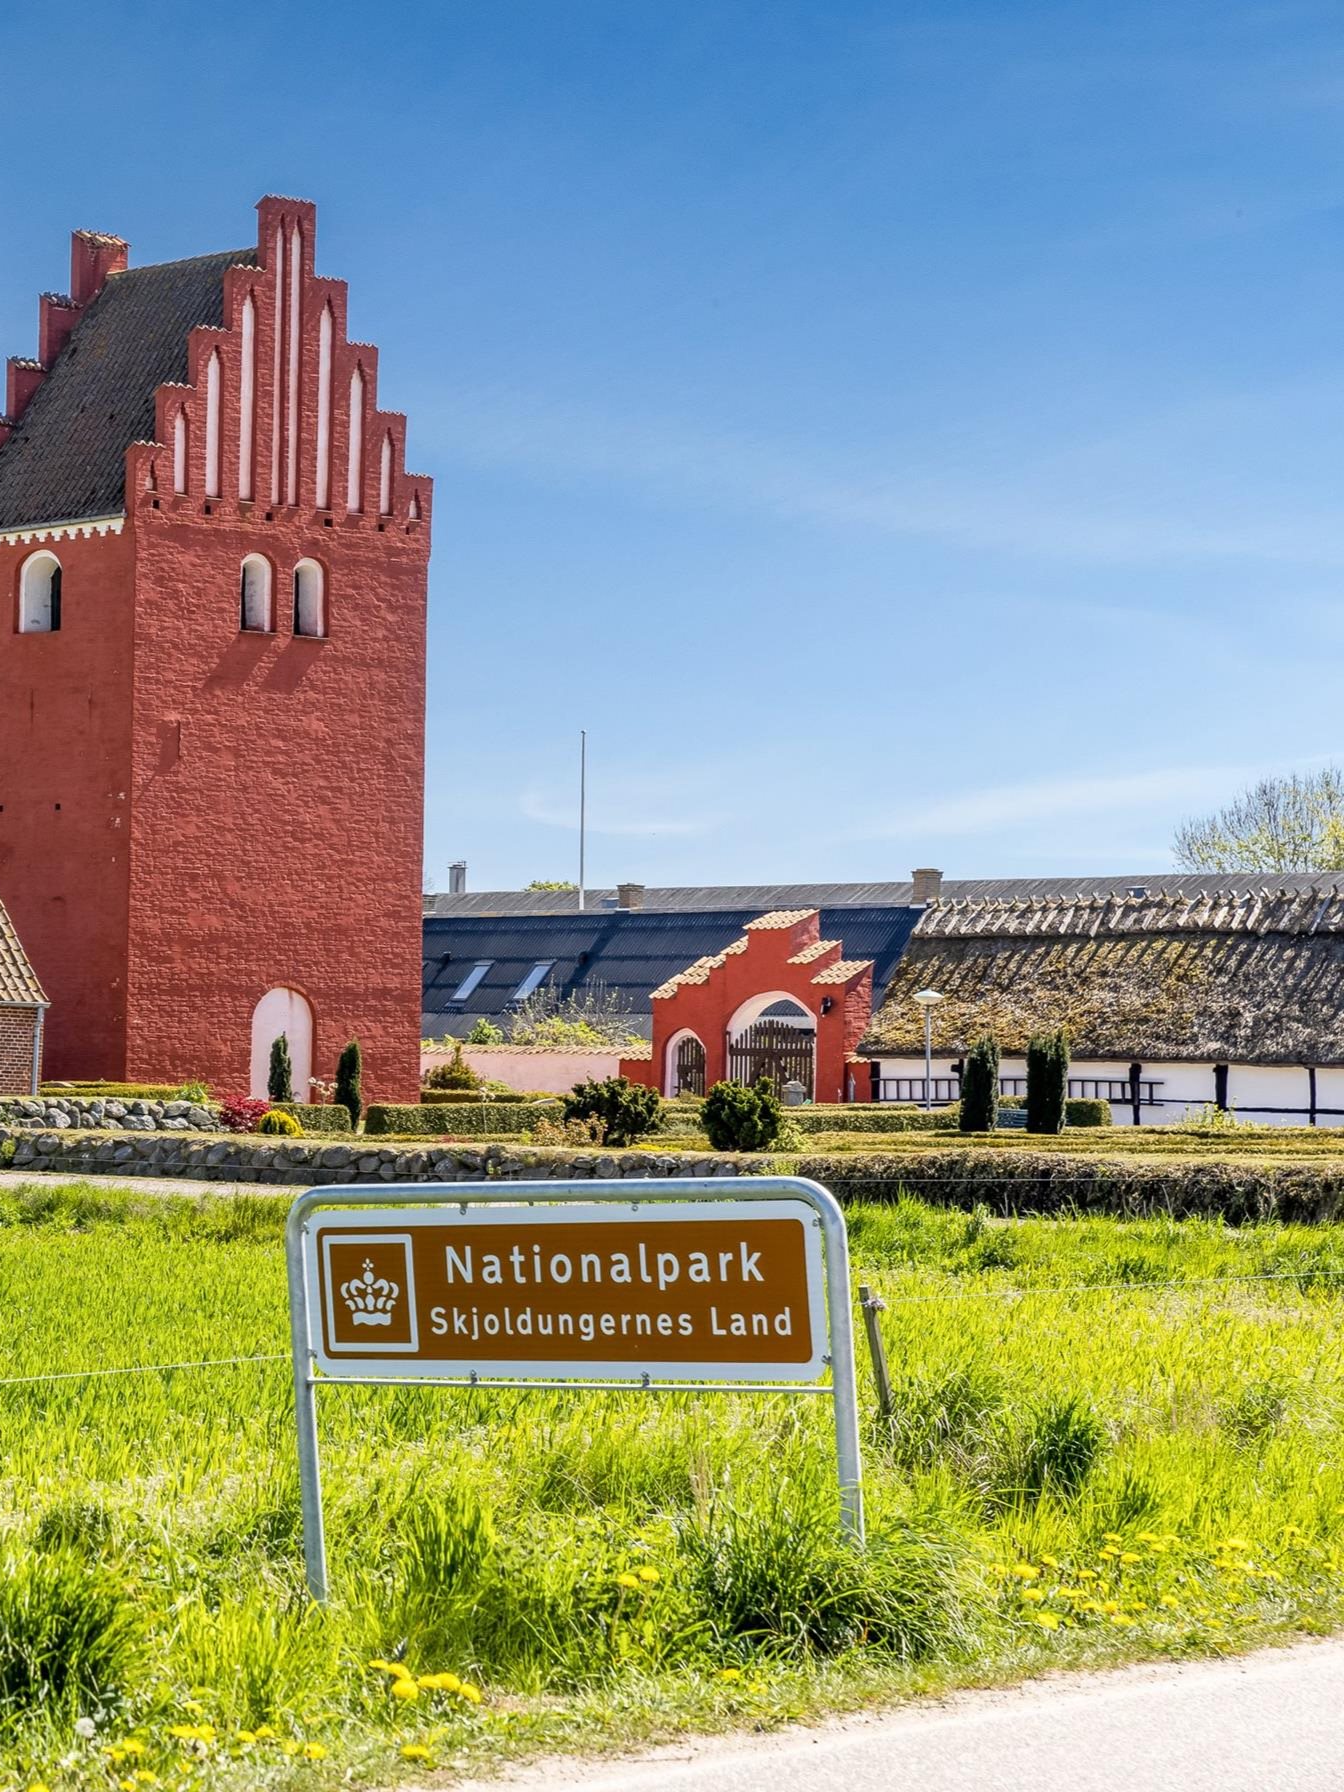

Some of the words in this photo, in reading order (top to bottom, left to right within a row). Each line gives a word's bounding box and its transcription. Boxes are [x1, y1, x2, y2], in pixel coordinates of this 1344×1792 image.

[444, 1241, 765, 1291] Nationalpark
[430, 1306, 694, 1341] Skjoldungernes
[710, 1306, 792, 1336] Land
